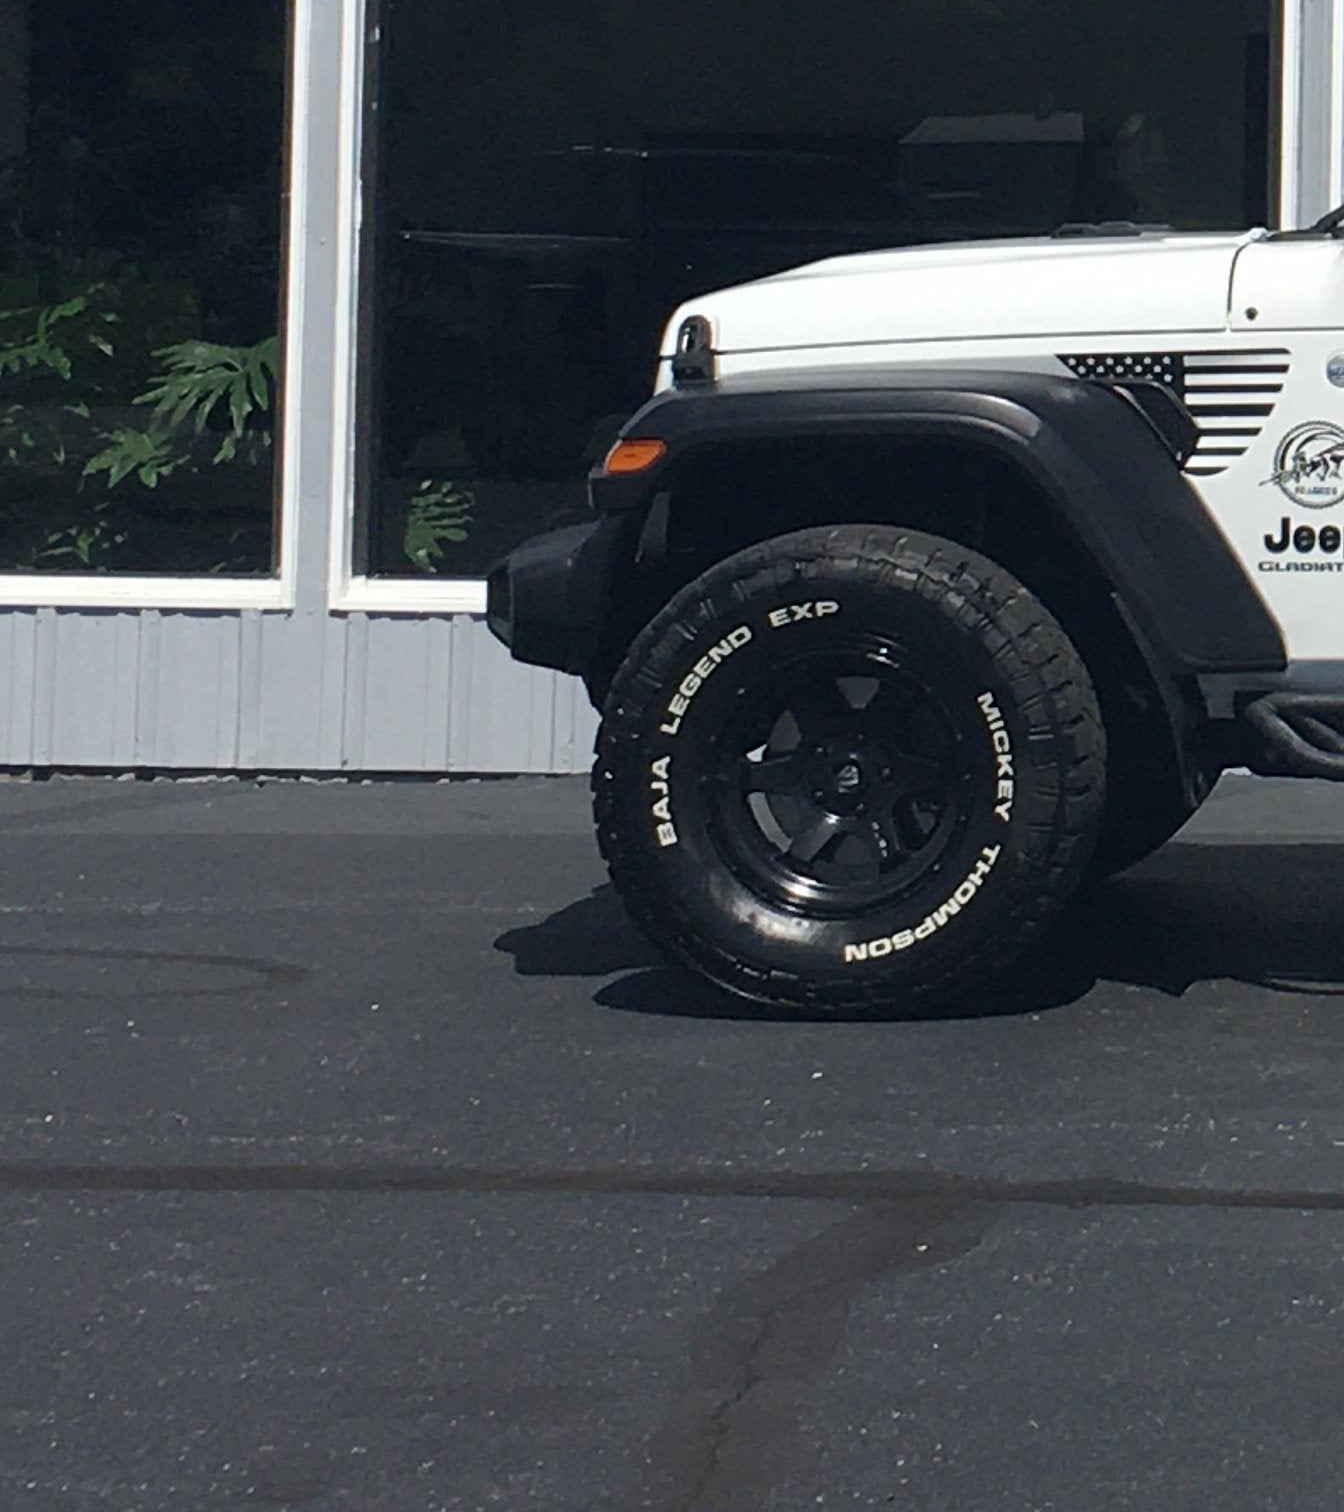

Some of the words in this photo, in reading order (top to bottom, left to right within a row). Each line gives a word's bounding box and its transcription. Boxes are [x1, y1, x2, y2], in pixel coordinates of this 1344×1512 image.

[768, 601, 840, 628] EXP
[660, 626, 752, 736] LEGEND
[651, 755, 678, 847] BAJA
[977, 691, 1014, 823] MICKEY
[844, 844, 1002, 963] THOMPSON
